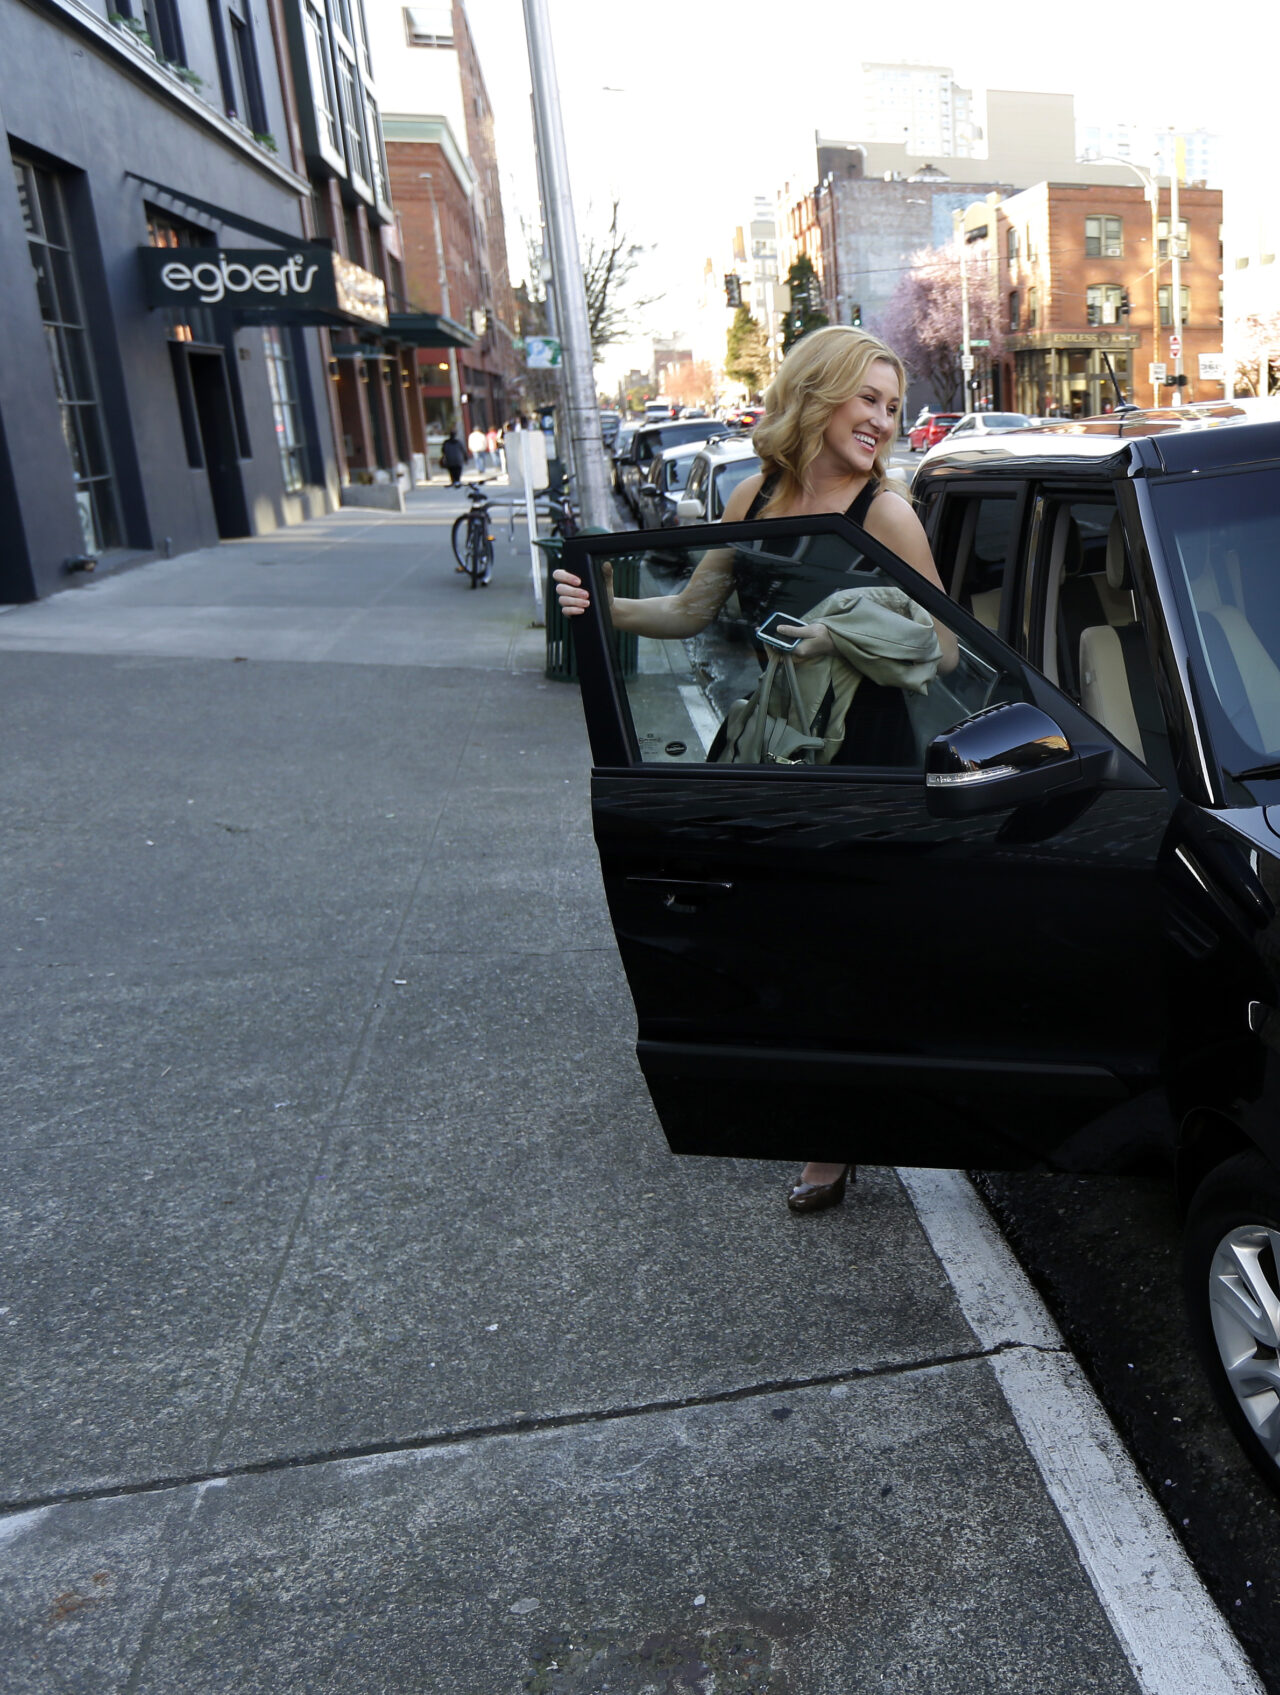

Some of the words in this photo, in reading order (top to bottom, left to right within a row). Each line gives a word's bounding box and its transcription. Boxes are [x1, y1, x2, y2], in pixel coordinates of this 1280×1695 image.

[161, 253, 318, 303] egbert's
[1053, 333, 1098, 343] ENDLESS
[1111, 333, 1137, 343] KT
